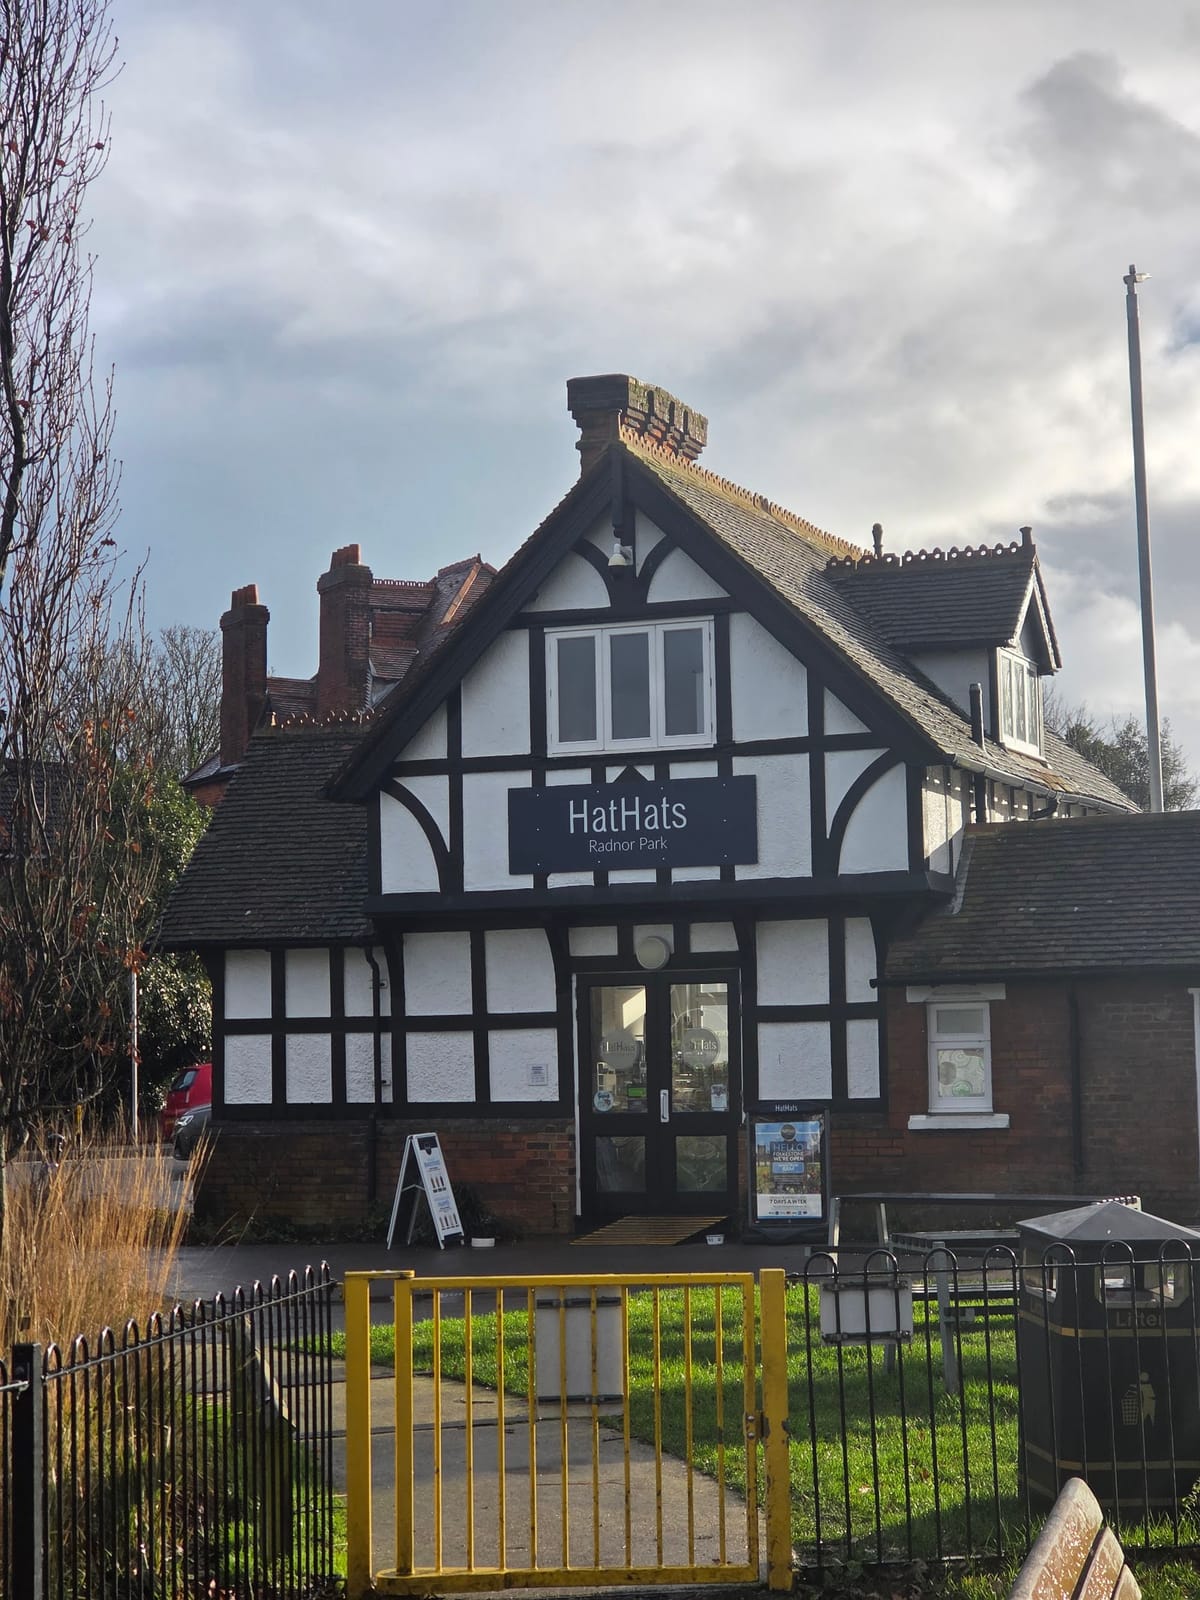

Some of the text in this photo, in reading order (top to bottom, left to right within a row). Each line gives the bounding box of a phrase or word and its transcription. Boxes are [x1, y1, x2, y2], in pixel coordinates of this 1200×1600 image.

[569, 796, 688, 834] HatHats
[589, 836, 668, 853] Radnor Park
[775, 1103, 798, 1112] HatHats
[773, 1143, 804, 1151] HELLO
